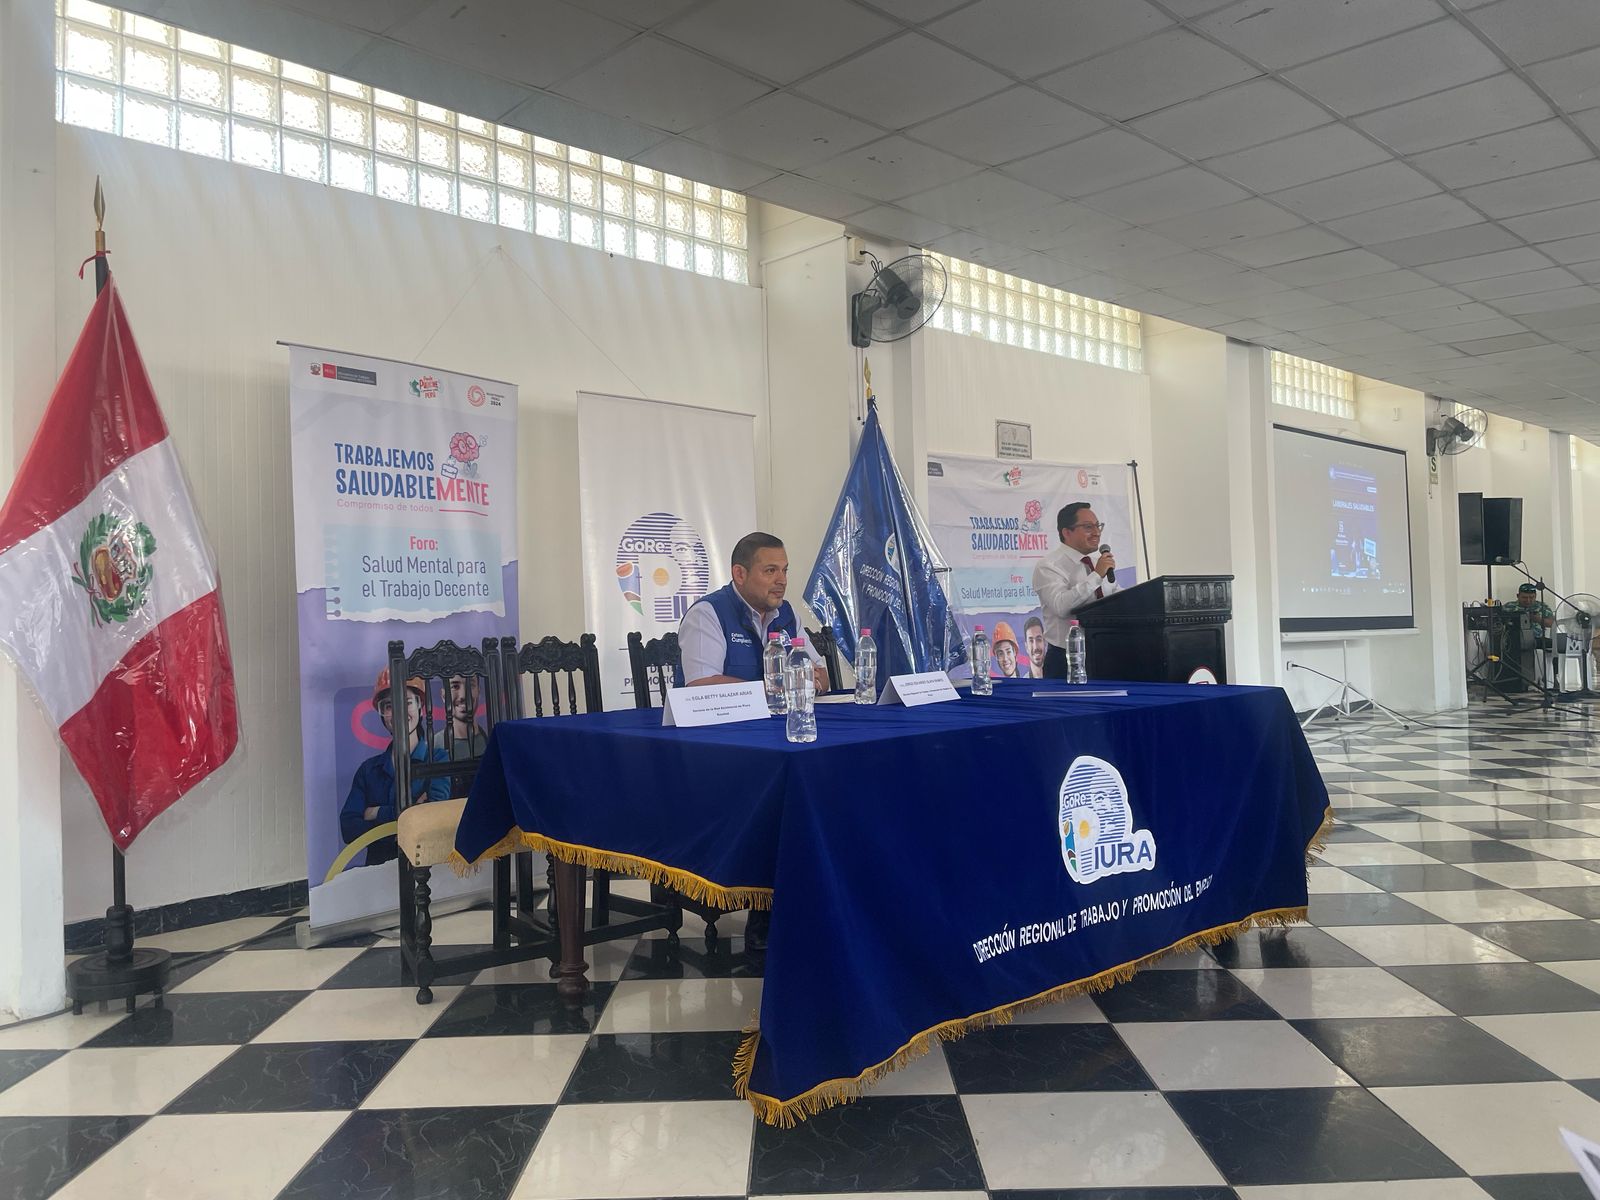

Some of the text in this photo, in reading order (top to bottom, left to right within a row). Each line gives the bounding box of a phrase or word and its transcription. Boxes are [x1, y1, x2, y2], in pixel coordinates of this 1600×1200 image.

[334, 443, 435, 471] TRABAJEMOS
[336, 469, 490, 506] SALUDABLEMENTE
[337, 499, 434, 513] Compromiso de todos
[969, 516, 1019, 531] TRABAJEMOS
[409, 536, 439, 550] Foro:
[971, 533, 1049, 551] SALUDABLEMENTE
[362, 556, 486, 577] Salud Mental para
[362, 580, 490, 600] el Trabajo Decente
[961, 587, 980, 599] Salud
[981, 587, 1003, 599] Mental
[1004, 588, 1018, 600] para
[972, 923, 1015, 964] DIRECCIÓN
[1019, 917, 1066, 947] REGIONAL
[1067, 912, 1077, 934] DE
[1080, 901, 1120, 928] TRABAJO
[1122, 898, 1129, 917] Y
[1132, 880, 1182, 916] PROMOCIÓN
[1183, 883, 1194, 903] DEL
